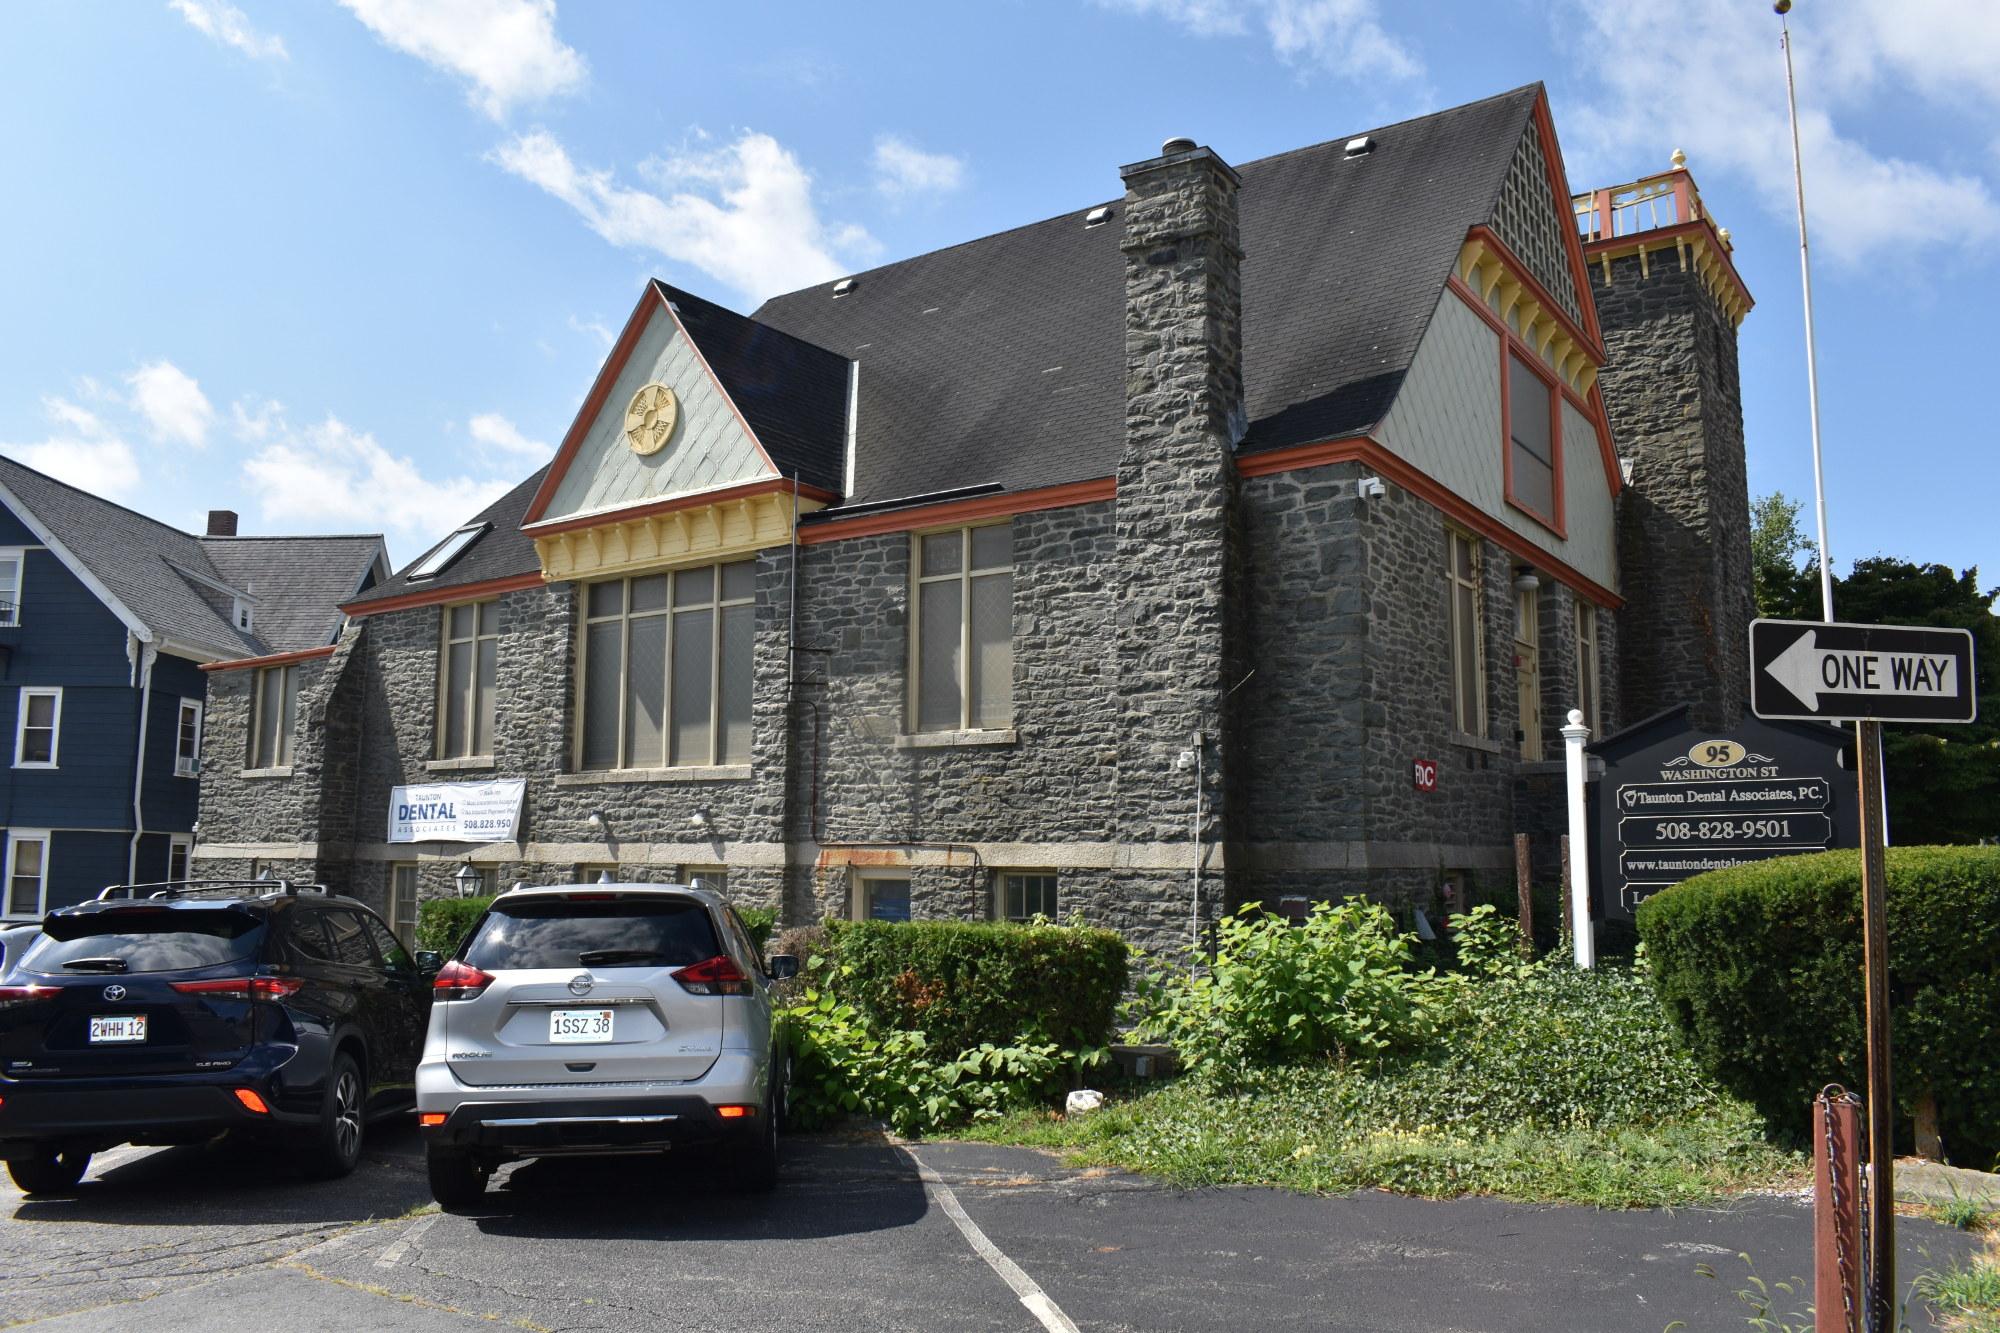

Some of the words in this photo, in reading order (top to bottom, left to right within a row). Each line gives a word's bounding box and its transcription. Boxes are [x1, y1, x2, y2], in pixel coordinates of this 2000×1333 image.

[1822, 654, 1881, 689] ONE
[1891, 657, 1949, 692] WAY
[1706, 745, 1730, 763] 95
[1415, 764, 1434, 787] FDC
[1660, 767, 1757, 780] WASHINGTON
[1760, 766, 1779, 777] ST
[415, 793, 442, 801] TAUNTON
[1638, 792, 1685, 804] Taunton
[1686, 789, 1726, 803] Dental
[1729, 788, 1797, 802] Associates,
[1798, 786, 1823, 799] PC.
[398, 802, 457, 821] DENTAL
[397, 825, 456, 833] ASSOCIATES
[463, 819, 511, 829] 508.828.950
[1655, 820, 1791, 840] 508-828-9501
[92, 1021, 123, 1037] 2WHH
[127, 1021, 144, 1036] 12
[553, 1018, 588, 1034] 1SSZ
[593, 1018, 610, 1034] 38
[452, 1051, 492, 1059] ROGUE
